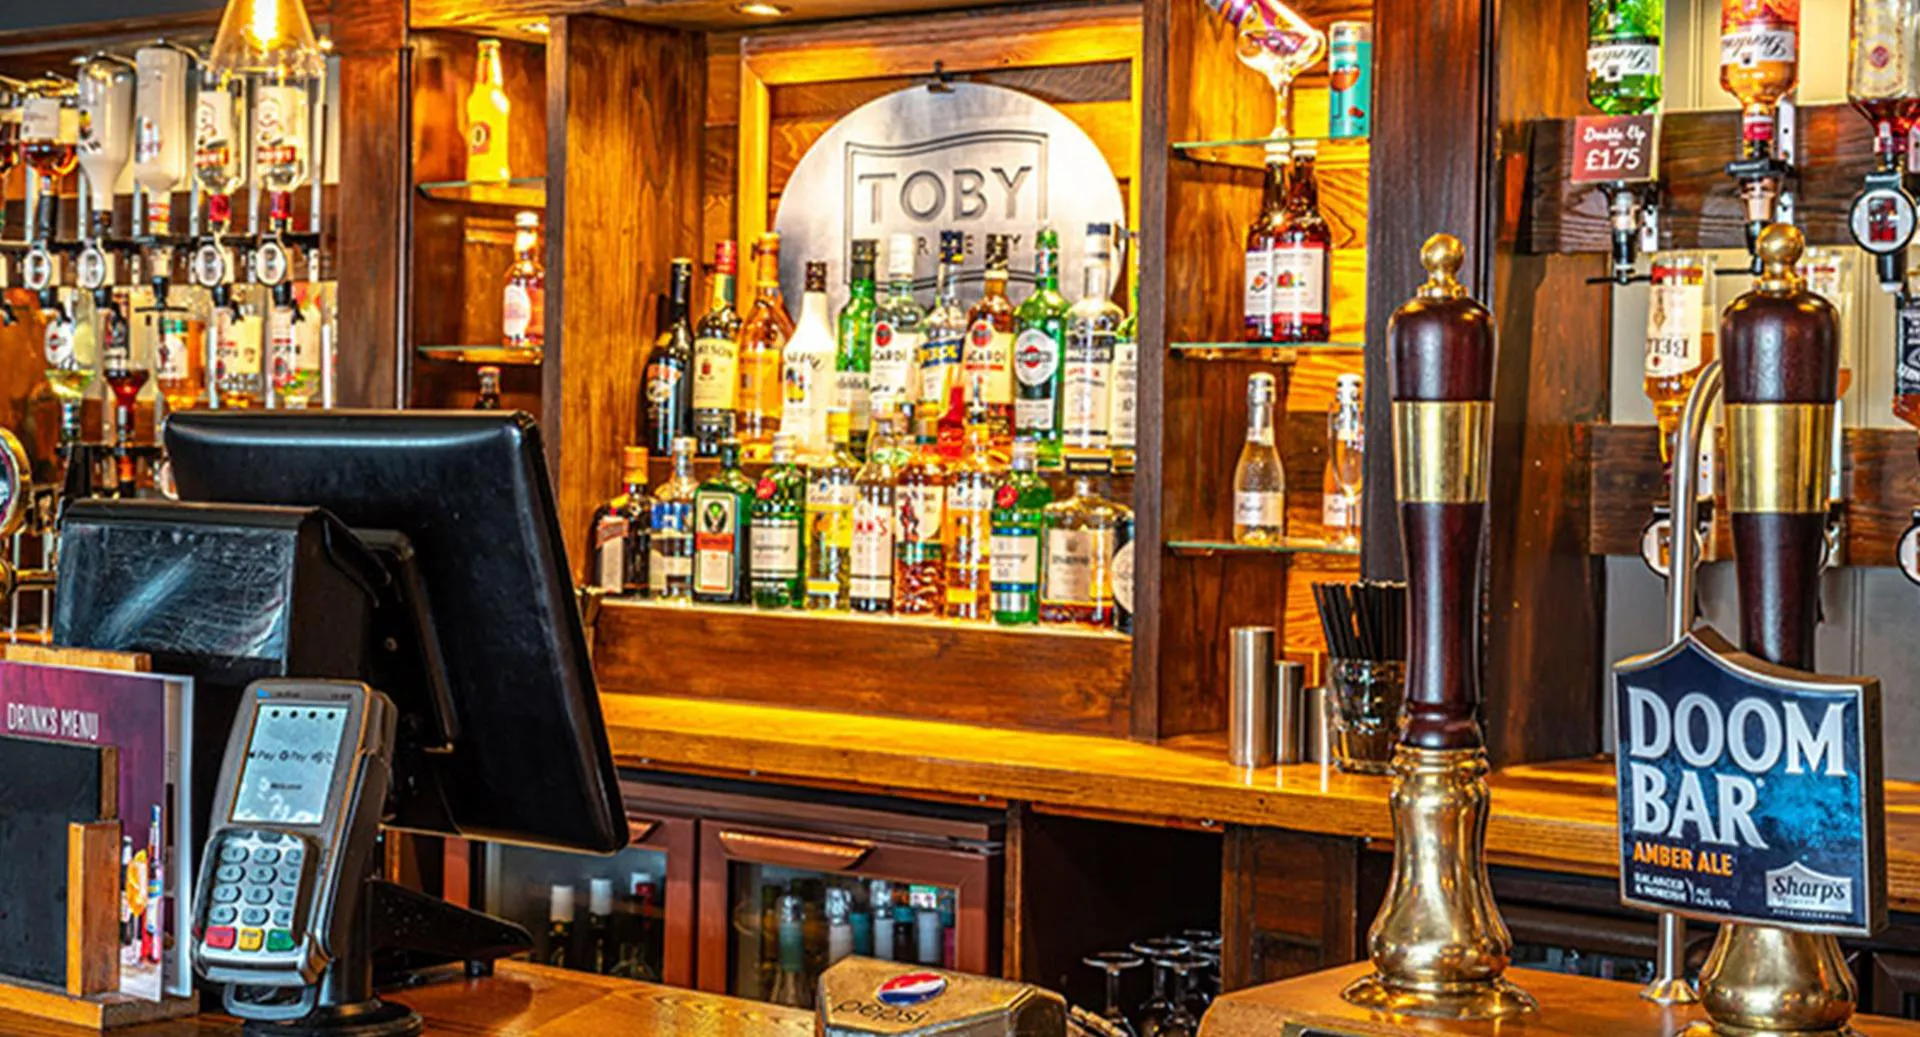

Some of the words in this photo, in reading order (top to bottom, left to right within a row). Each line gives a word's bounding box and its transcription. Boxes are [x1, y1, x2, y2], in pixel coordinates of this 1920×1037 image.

[1584, 126, 1623, 143] Double
[1626, 123, 1646, 146] Up
[1585, 147, 1641, 171] £1.75
[858, 165, 1032, 224] TOBY
[7, 702, 58, 736] DRINKS
[61, 709, 99, 741] MENU
[1627, 686, 1849, 776] DOOM
[1631, 762, 1769, 849] BAR
[1633, 841, 1694, 872] AMBER
[1697, 851, 1734, 877] ALE
[1772, 875, 1846, 904] Sharp's
[831, 1000, 931, 1025] pepsi
